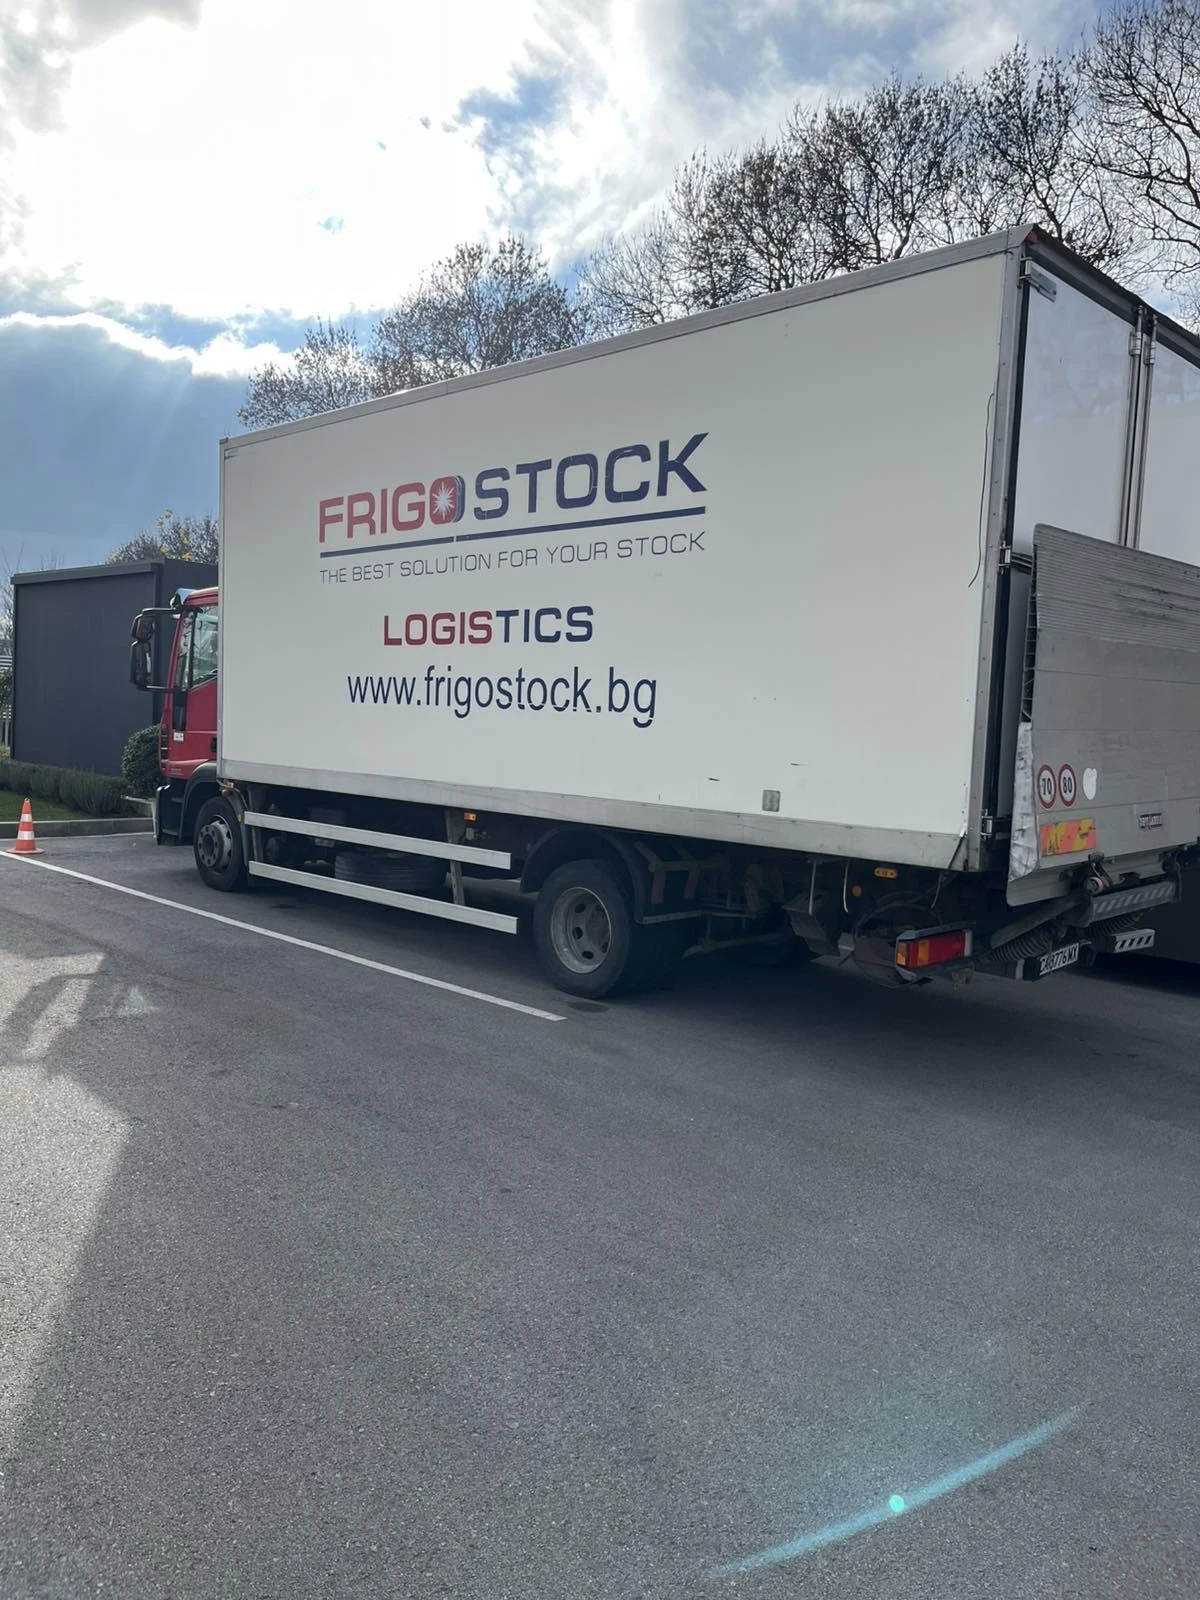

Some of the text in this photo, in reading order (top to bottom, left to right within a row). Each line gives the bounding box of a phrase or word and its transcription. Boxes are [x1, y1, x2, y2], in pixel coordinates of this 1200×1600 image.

[319, 432, 709, 543] FRIGOSTOCK
[320, 531, 705, 584] THE BEST SOLUTION FOR YOUR STOCK
[383, 605, 594, 646] LOGISTICS
[347, 664, 657, 729] www.frigostock.bg
[1042, 777, 1052, 795] 70
[1063, 776, 1072, 794] 80
